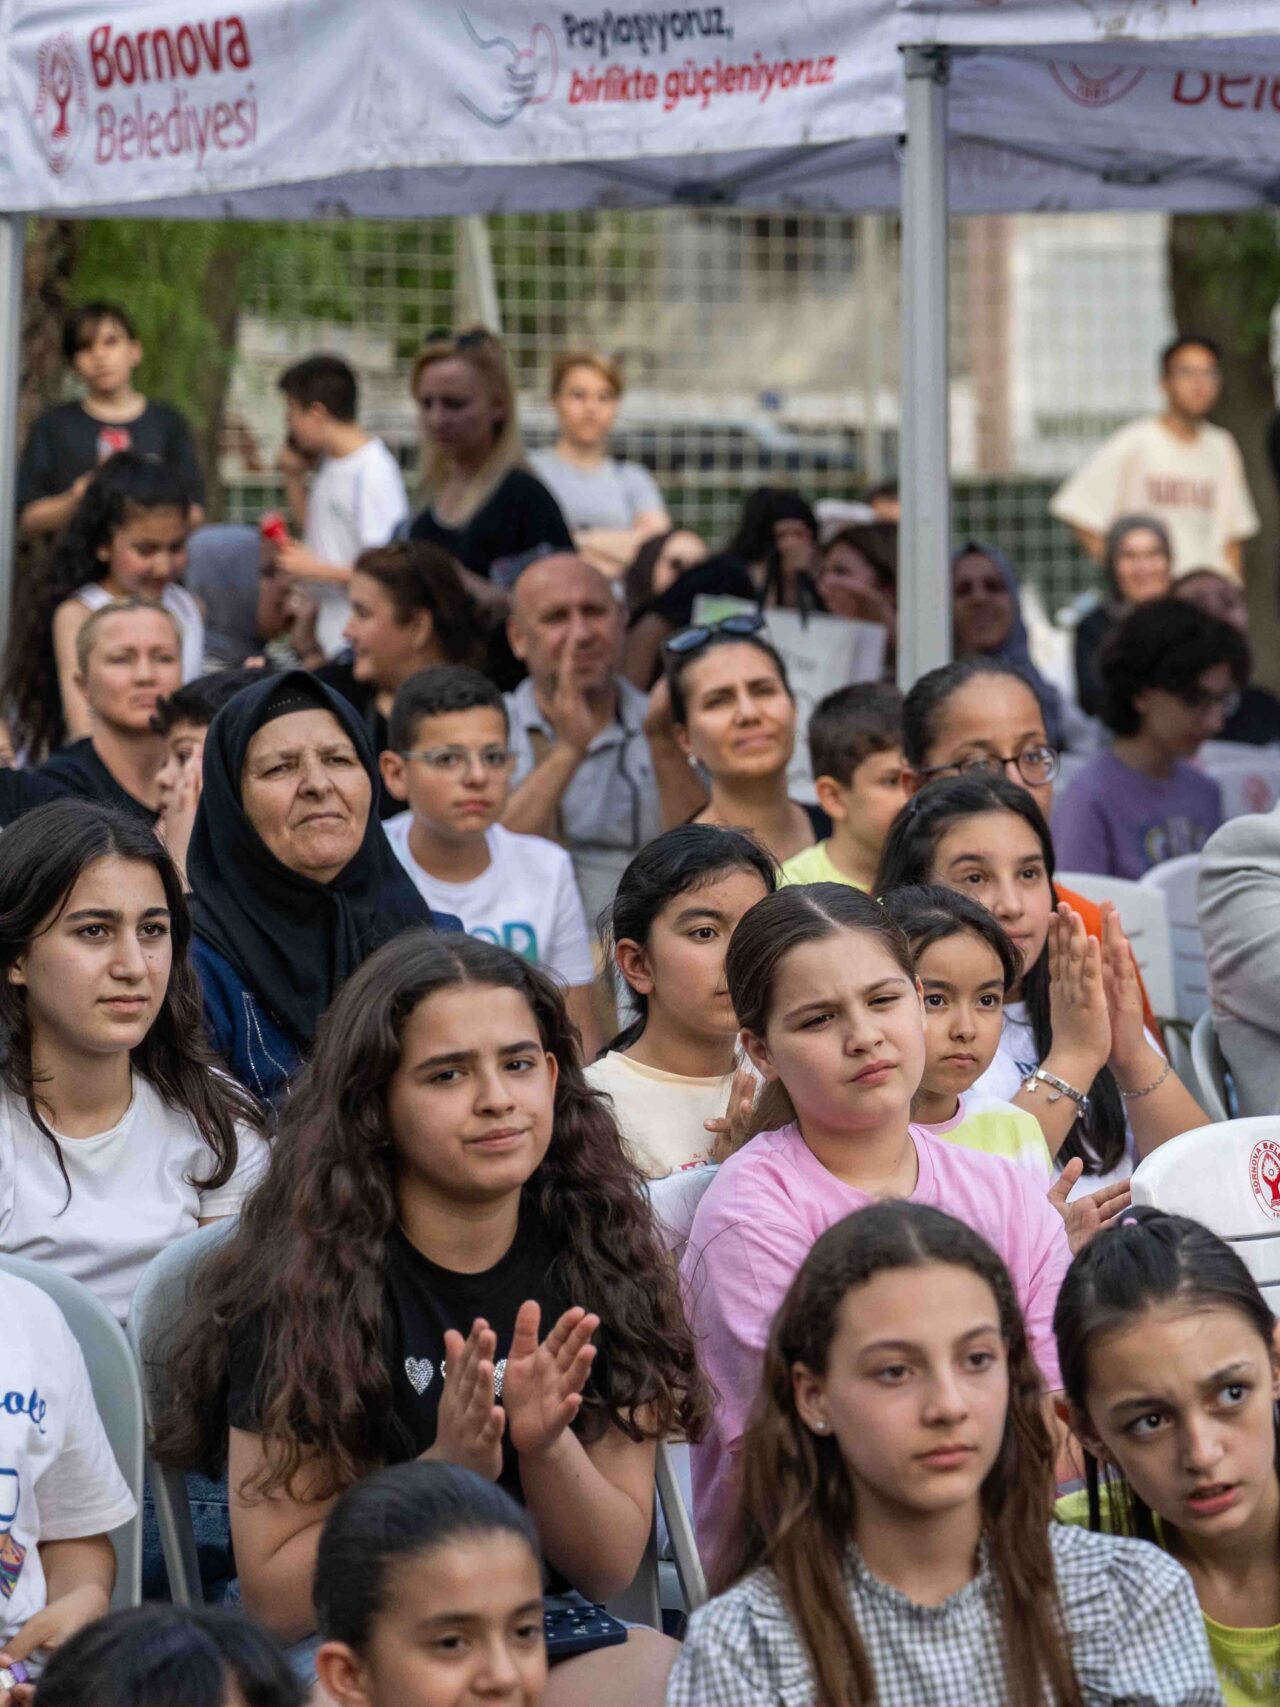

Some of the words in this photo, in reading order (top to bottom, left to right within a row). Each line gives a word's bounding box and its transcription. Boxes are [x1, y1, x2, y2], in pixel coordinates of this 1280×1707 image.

[89, 15, 252, 89] Bornova
[561, 7, 734, 57] Paylaşıyoruz,
[568, 64, 659, 104] birlikte
[663, 51, 837, 111] güçleniyoruz
[94, 82, 258, 171] Belediyesi
